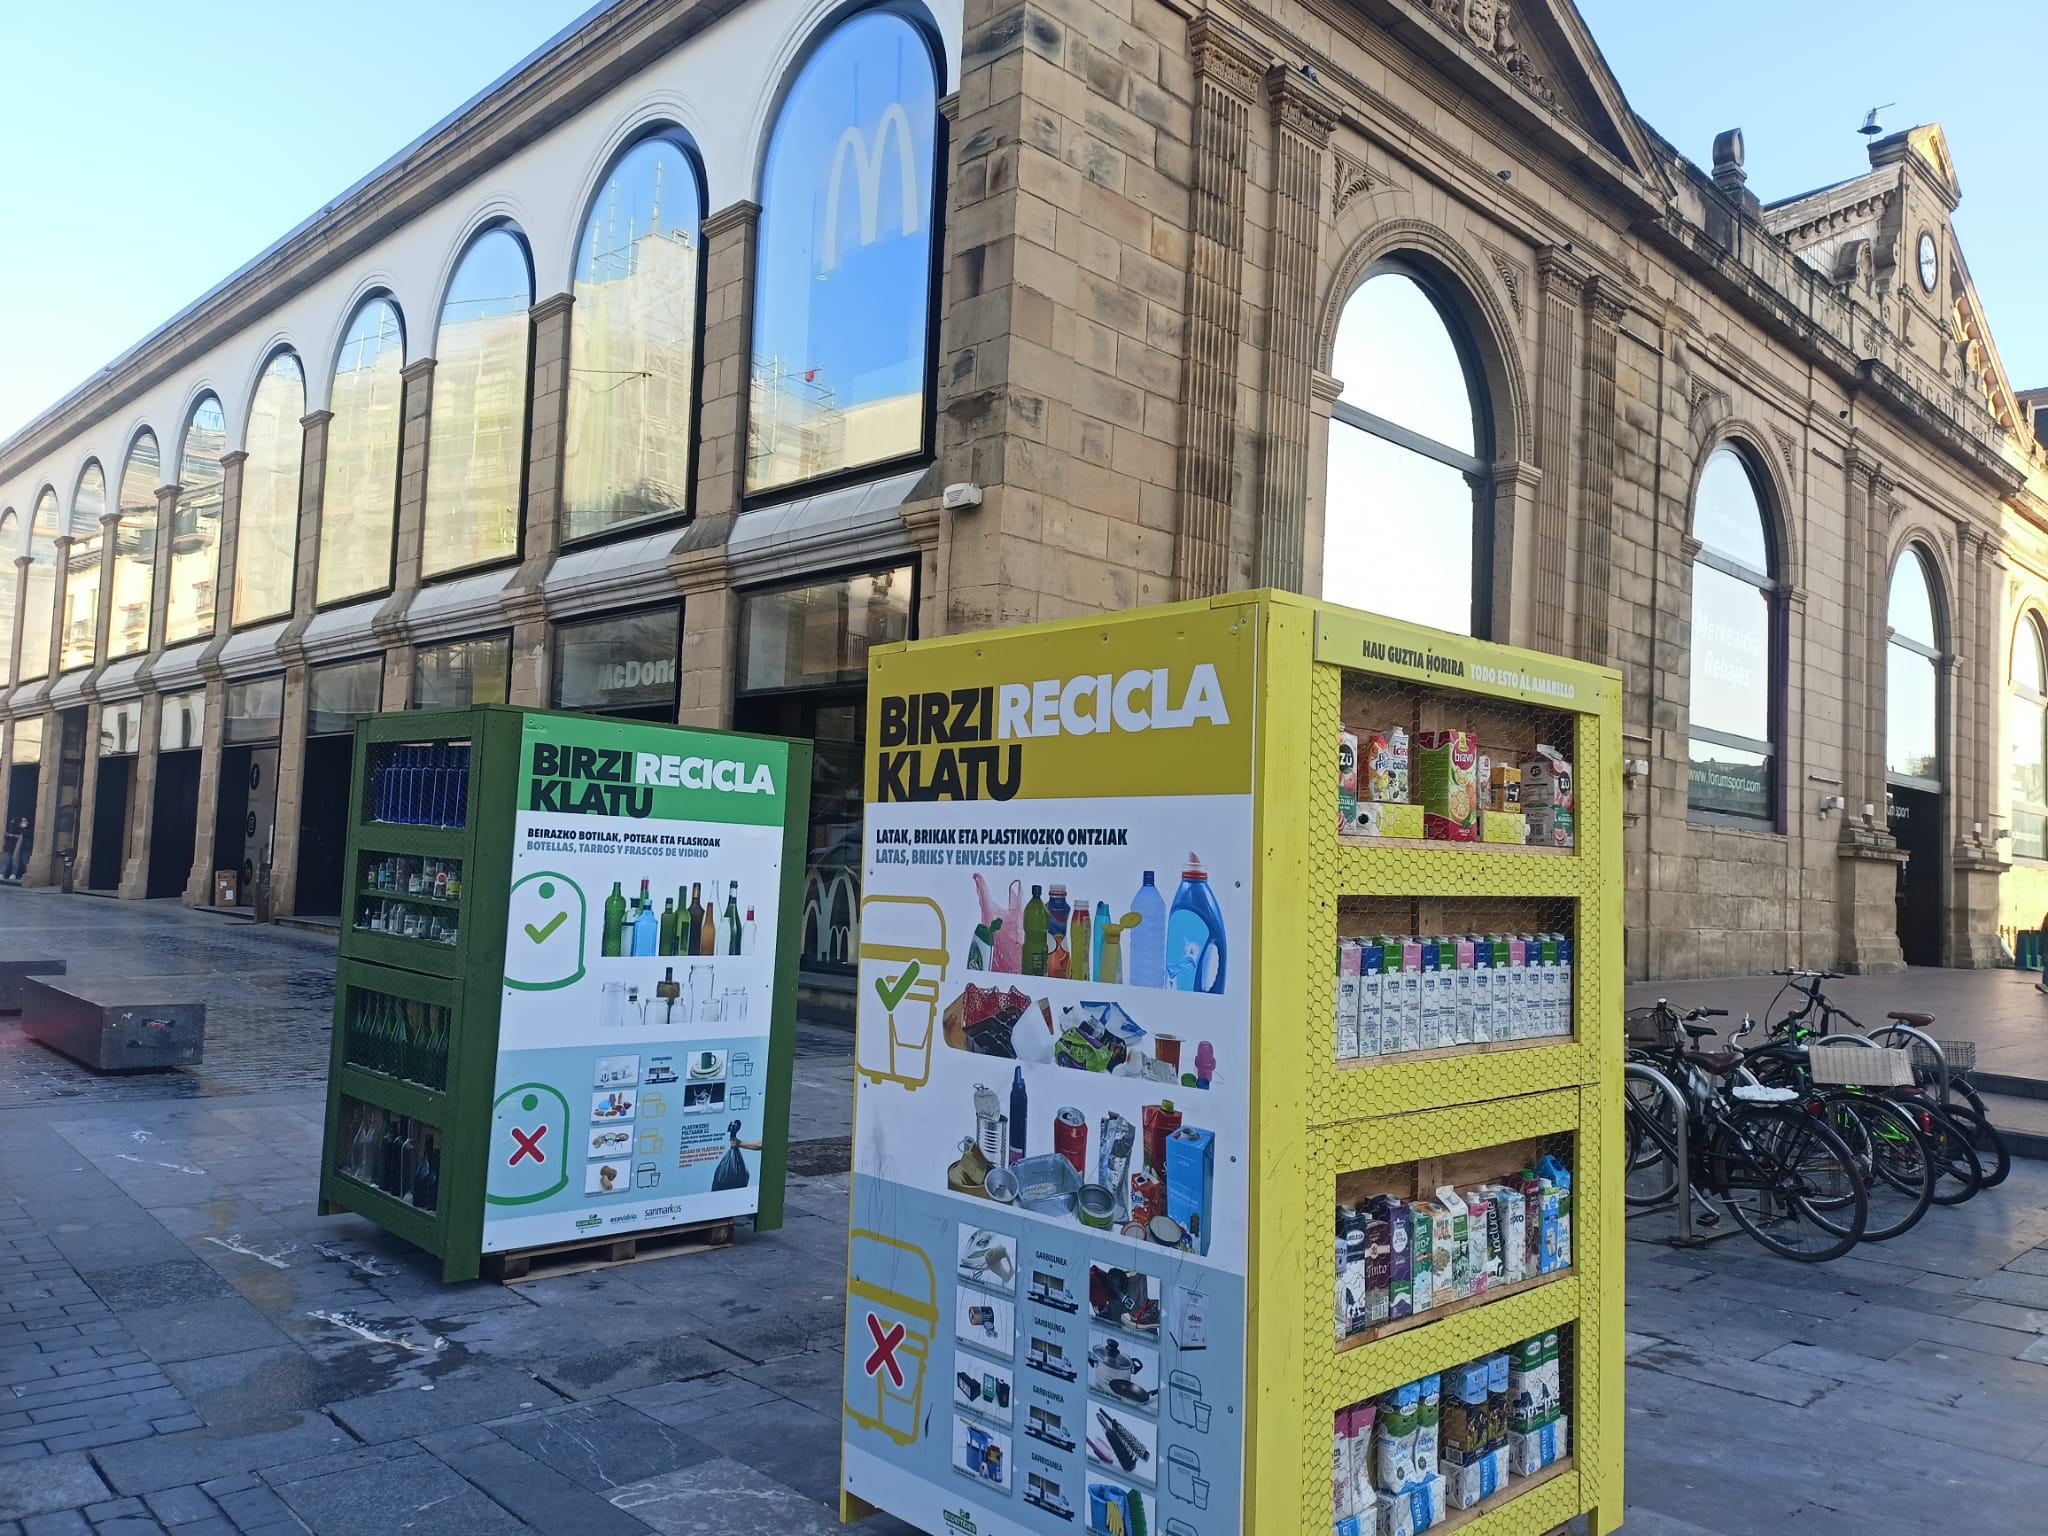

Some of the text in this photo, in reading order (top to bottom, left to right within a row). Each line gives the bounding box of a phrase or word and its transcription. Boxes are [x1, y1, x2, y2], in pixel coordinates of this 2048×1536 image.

[1362, 640, 1575, 700] HAU GUZTIA HORIRA TODO ESTO AL AMARILLO
[880, 663, 1231, 748] BIRZI RECICLA
[532, 742, 776, 796] BIRZI RECICLA
[877, 744, 1023, 803] KLATU
[1688, 768, 1761, 793] www.forumsport.com
[529, 778, 654, 819] KLATU
[526, 840, 709, 859] BOTELLAS, TARROS Y FRASCOS DE VIDRIO
[527, 828, 721, 848] BEIRAZKO BOTILAK, POTEAK ETA FLASKOAK
[876, 828, 1128, 846] LATAK, BRIKAK ETA PLASTIKOZKO ONTZIAK
[875, 846, 1088, 868] LATAS, BRIKS Y ENVASES DE PLÁSTICO
